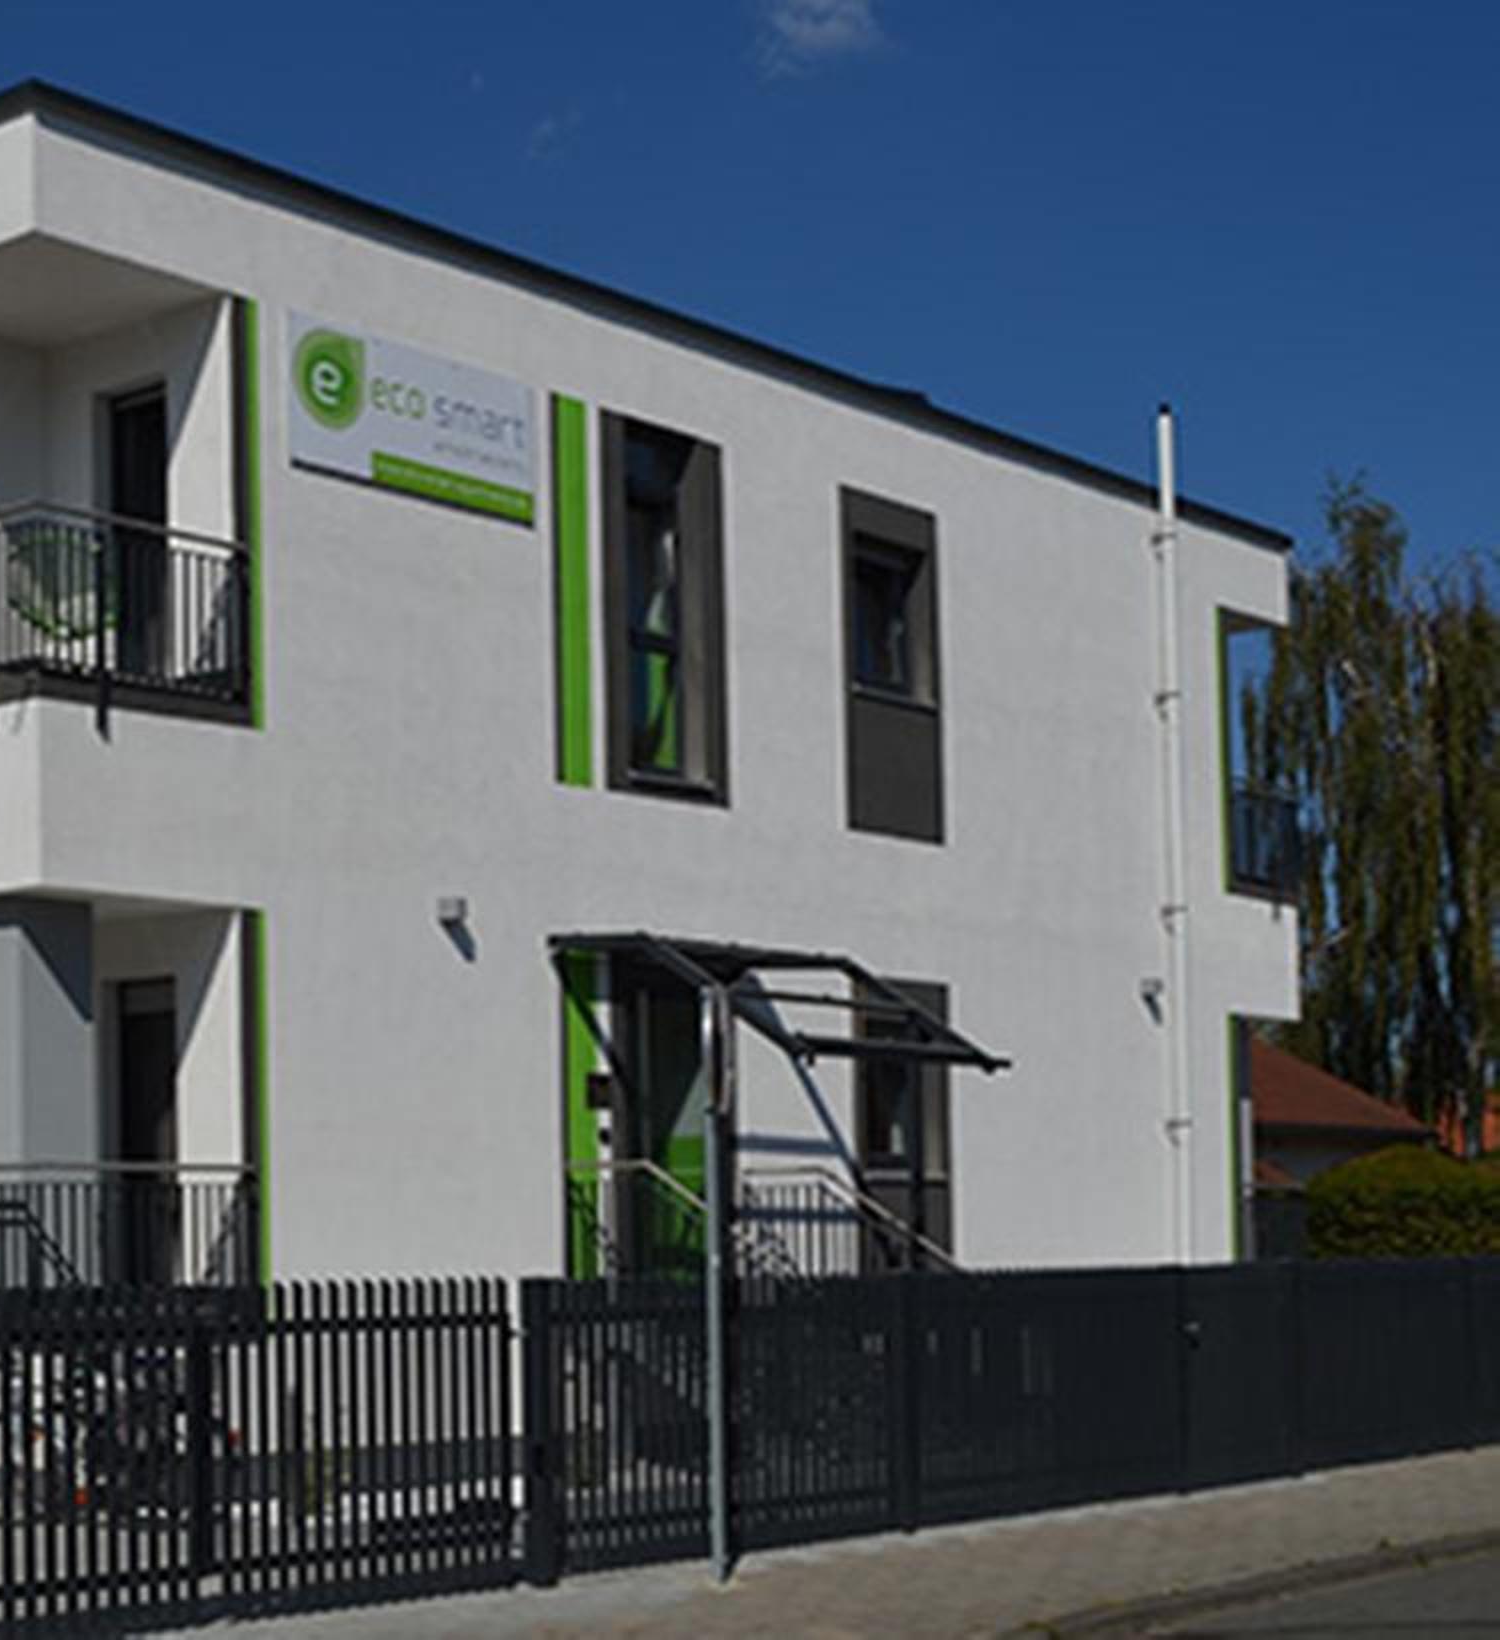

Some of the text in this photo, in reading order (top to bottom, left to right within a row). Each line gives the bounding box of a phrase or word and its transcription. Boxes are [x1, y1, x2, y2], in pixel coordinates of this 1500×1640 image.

[311, 360, 344, 406] e
[371, 376, 525, 450] eco smart
